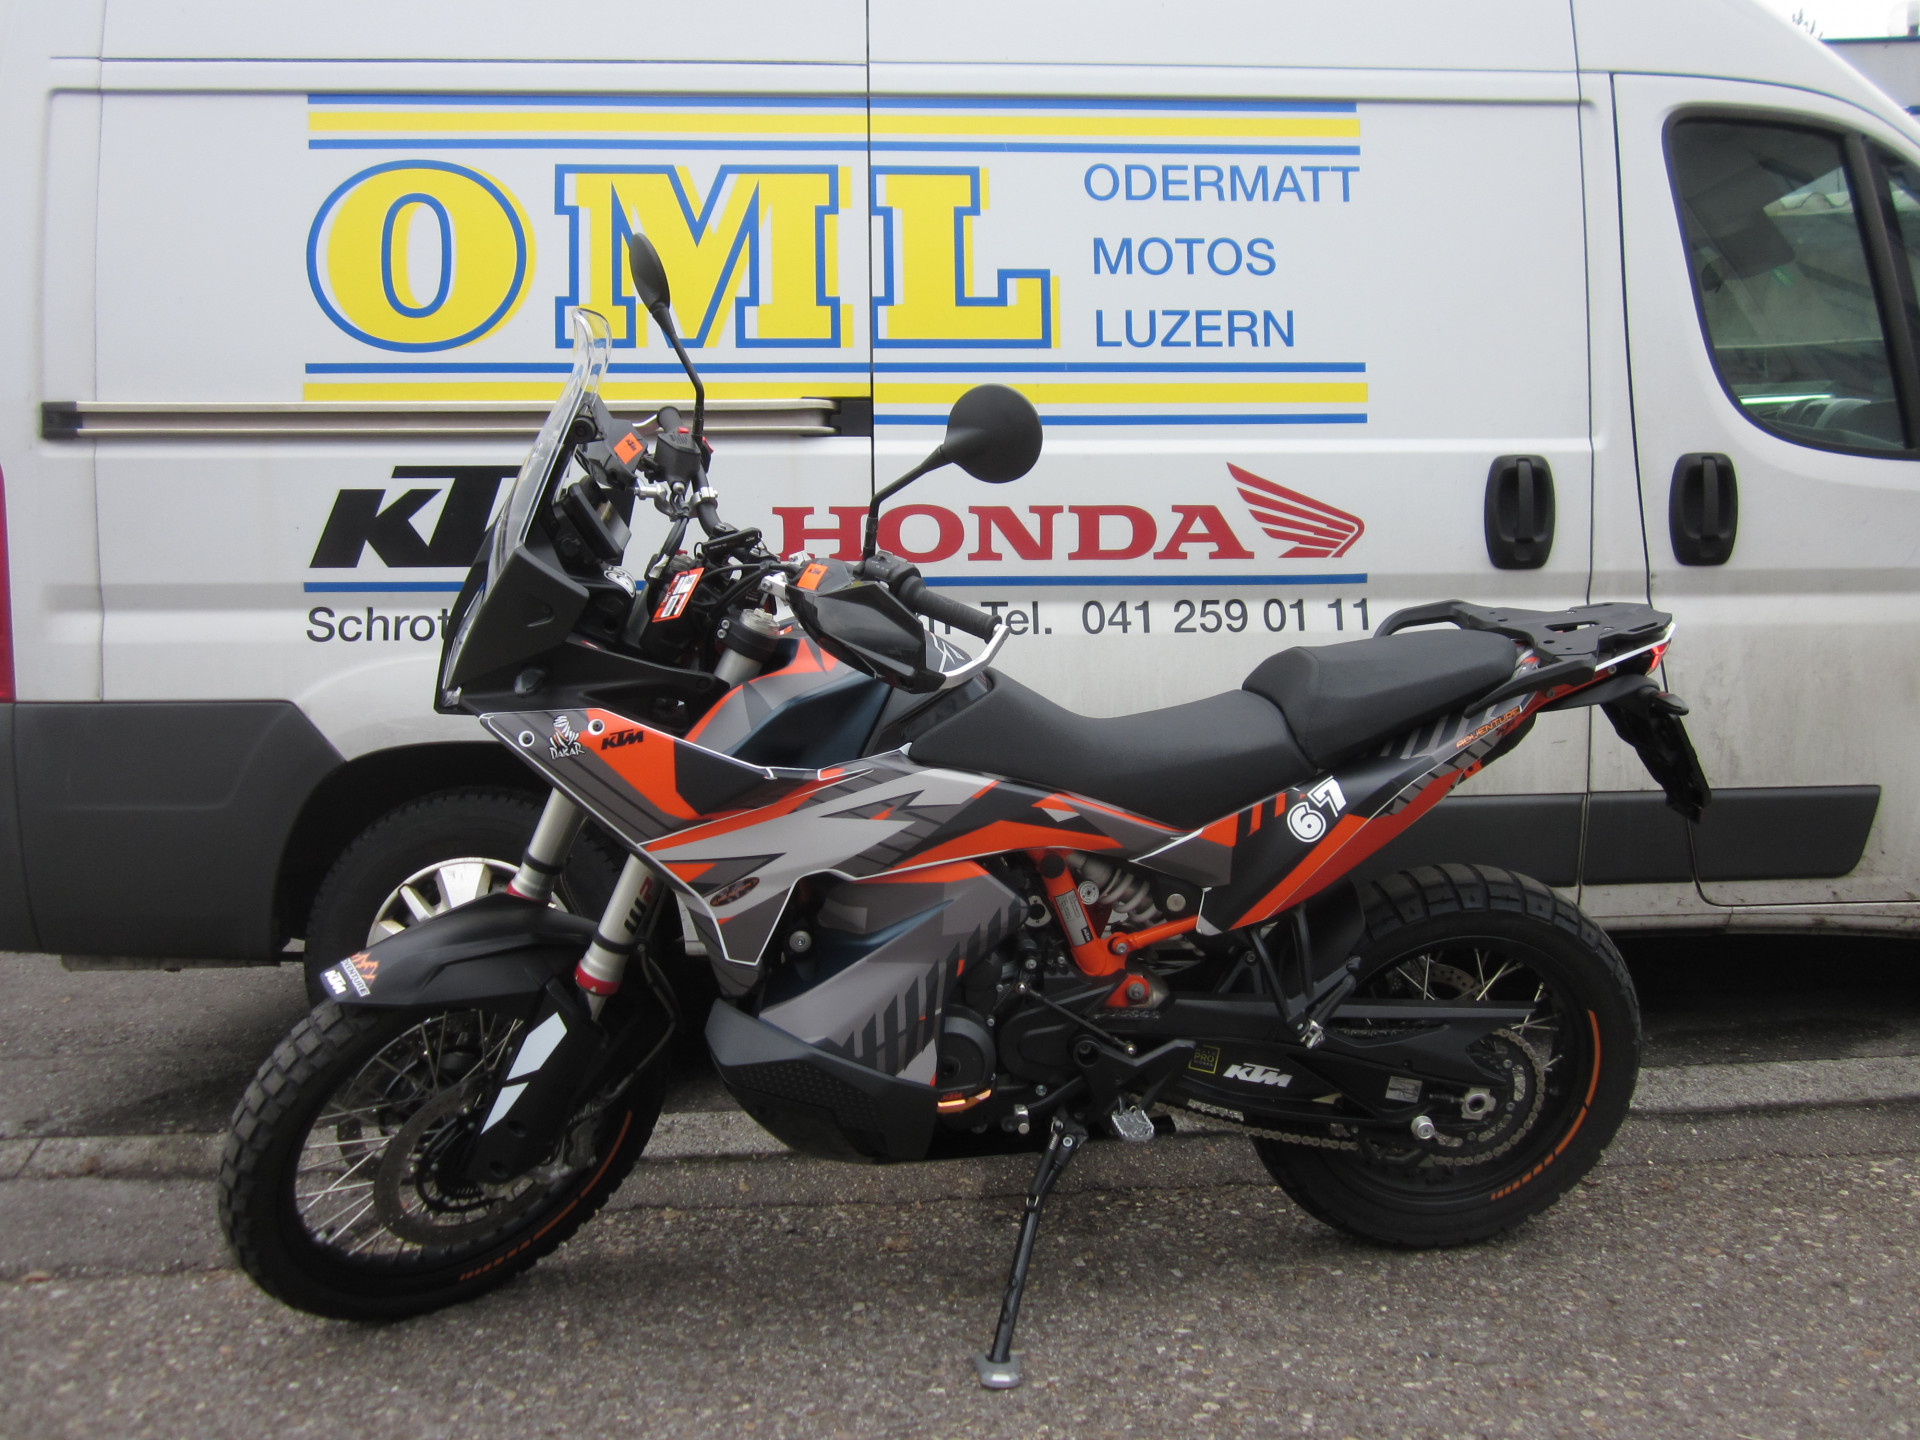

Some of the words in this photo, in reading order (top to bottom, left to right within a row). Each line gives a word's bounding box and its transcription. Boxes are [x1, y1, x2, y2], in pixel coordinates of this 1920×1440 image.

[1083, 163, 1360, 204] ODERMATT
[306, 159, 1060, 352] OML
[1093, 236, 1276, 276] MOTOS
[1095, 309, 1296, 348] LUZERN
[309, 465, 522, 569] KT
[772, 504, 1255, 563] HONDA
[306, 606, 451, 643] Schrot
[981, 601, 1052, 635] Tel.
[1081, 600, 1151, 635] 041
[1173, 600, 1248, 634] 259
[1263, 599, 1311, 633] 01
[1329, 598, 1371, 632] 11
[601, 728, 644, 750] KTM
[1456, 706, 1520, 750] ADVENTURE
[549, 742, 585, 760] DAKAR
[1286, 775, 1348, 843] 67
[324, 969, 347, 994] KTM
[1194, 1052, 1215, 1062] PRO
[1222, 1062, 1293, 1088] KTM
